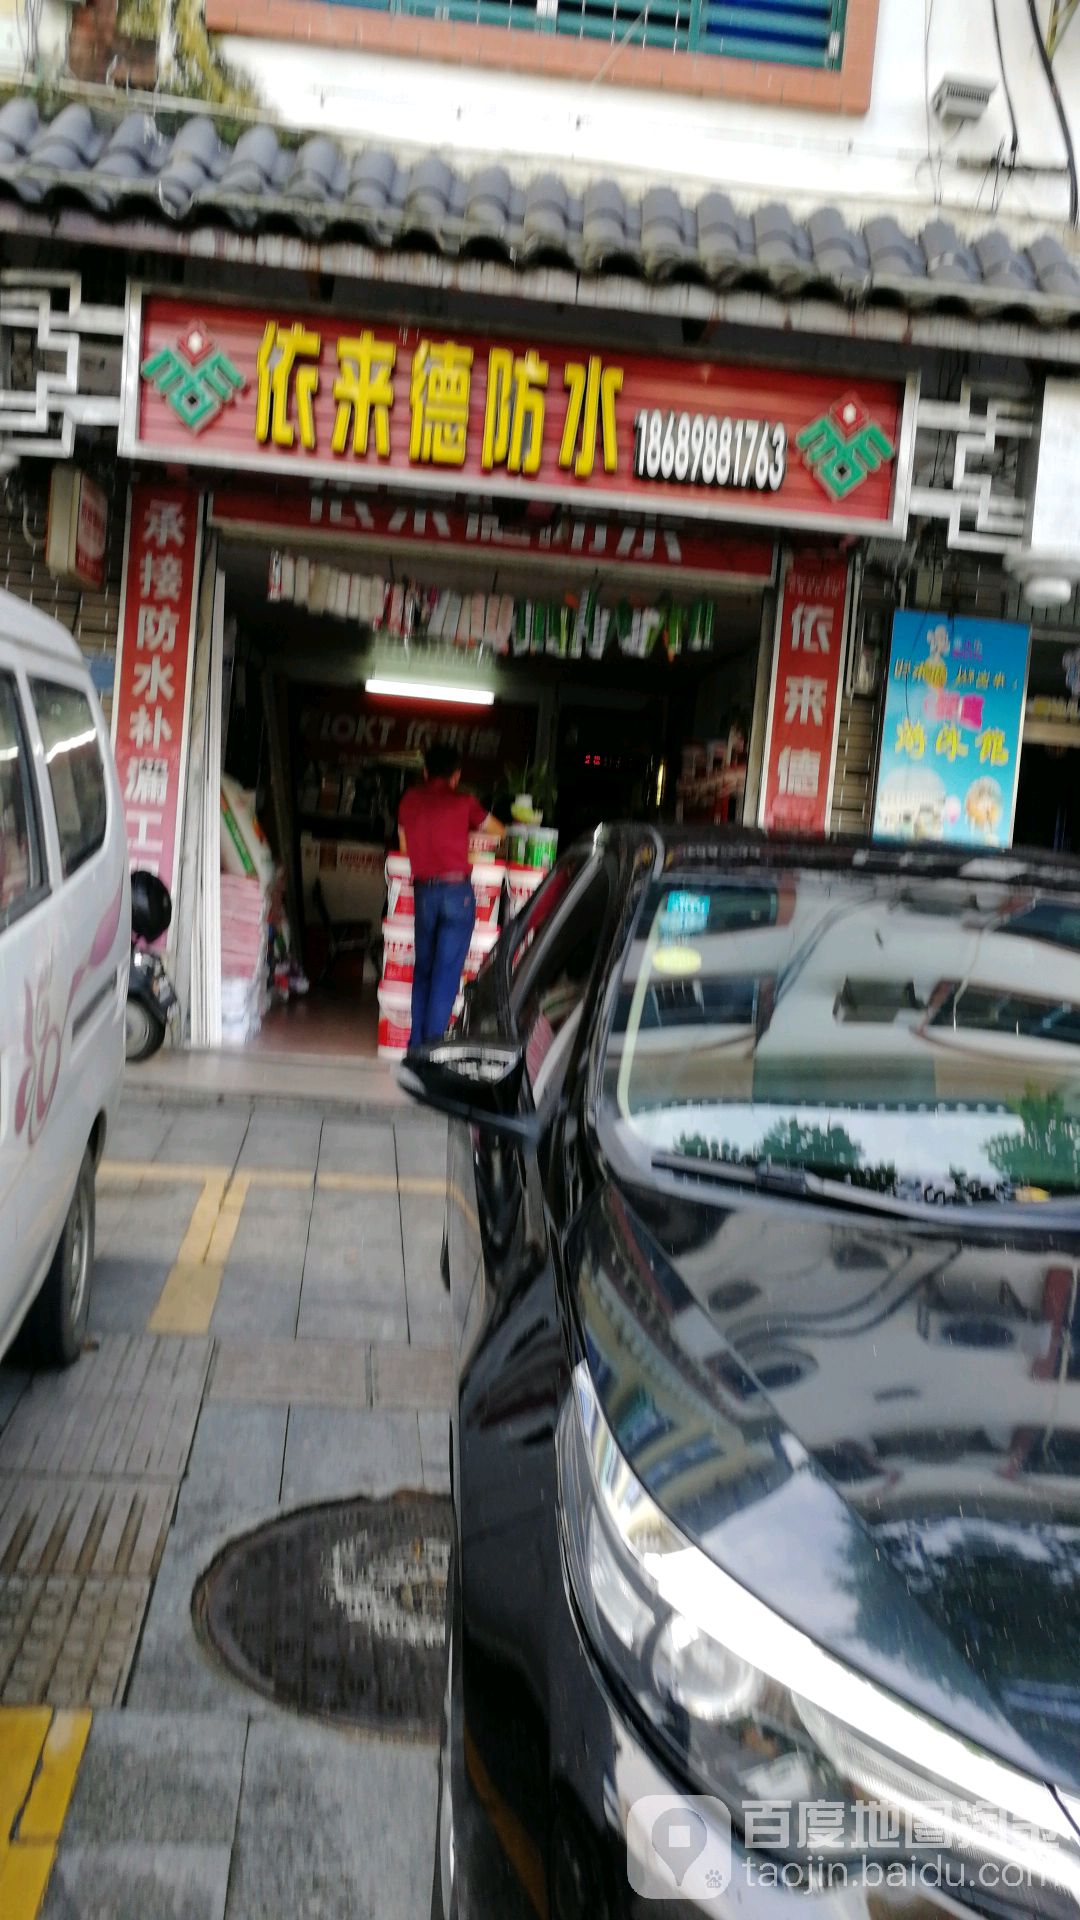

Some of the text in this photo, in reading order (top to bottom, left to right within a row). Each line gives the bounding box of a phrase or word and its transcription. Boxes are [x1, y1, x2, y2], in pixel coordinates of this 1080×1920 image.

[255, 318, 624, 479] 依来德防水
[636, 407, 787, 491] 18689881763
